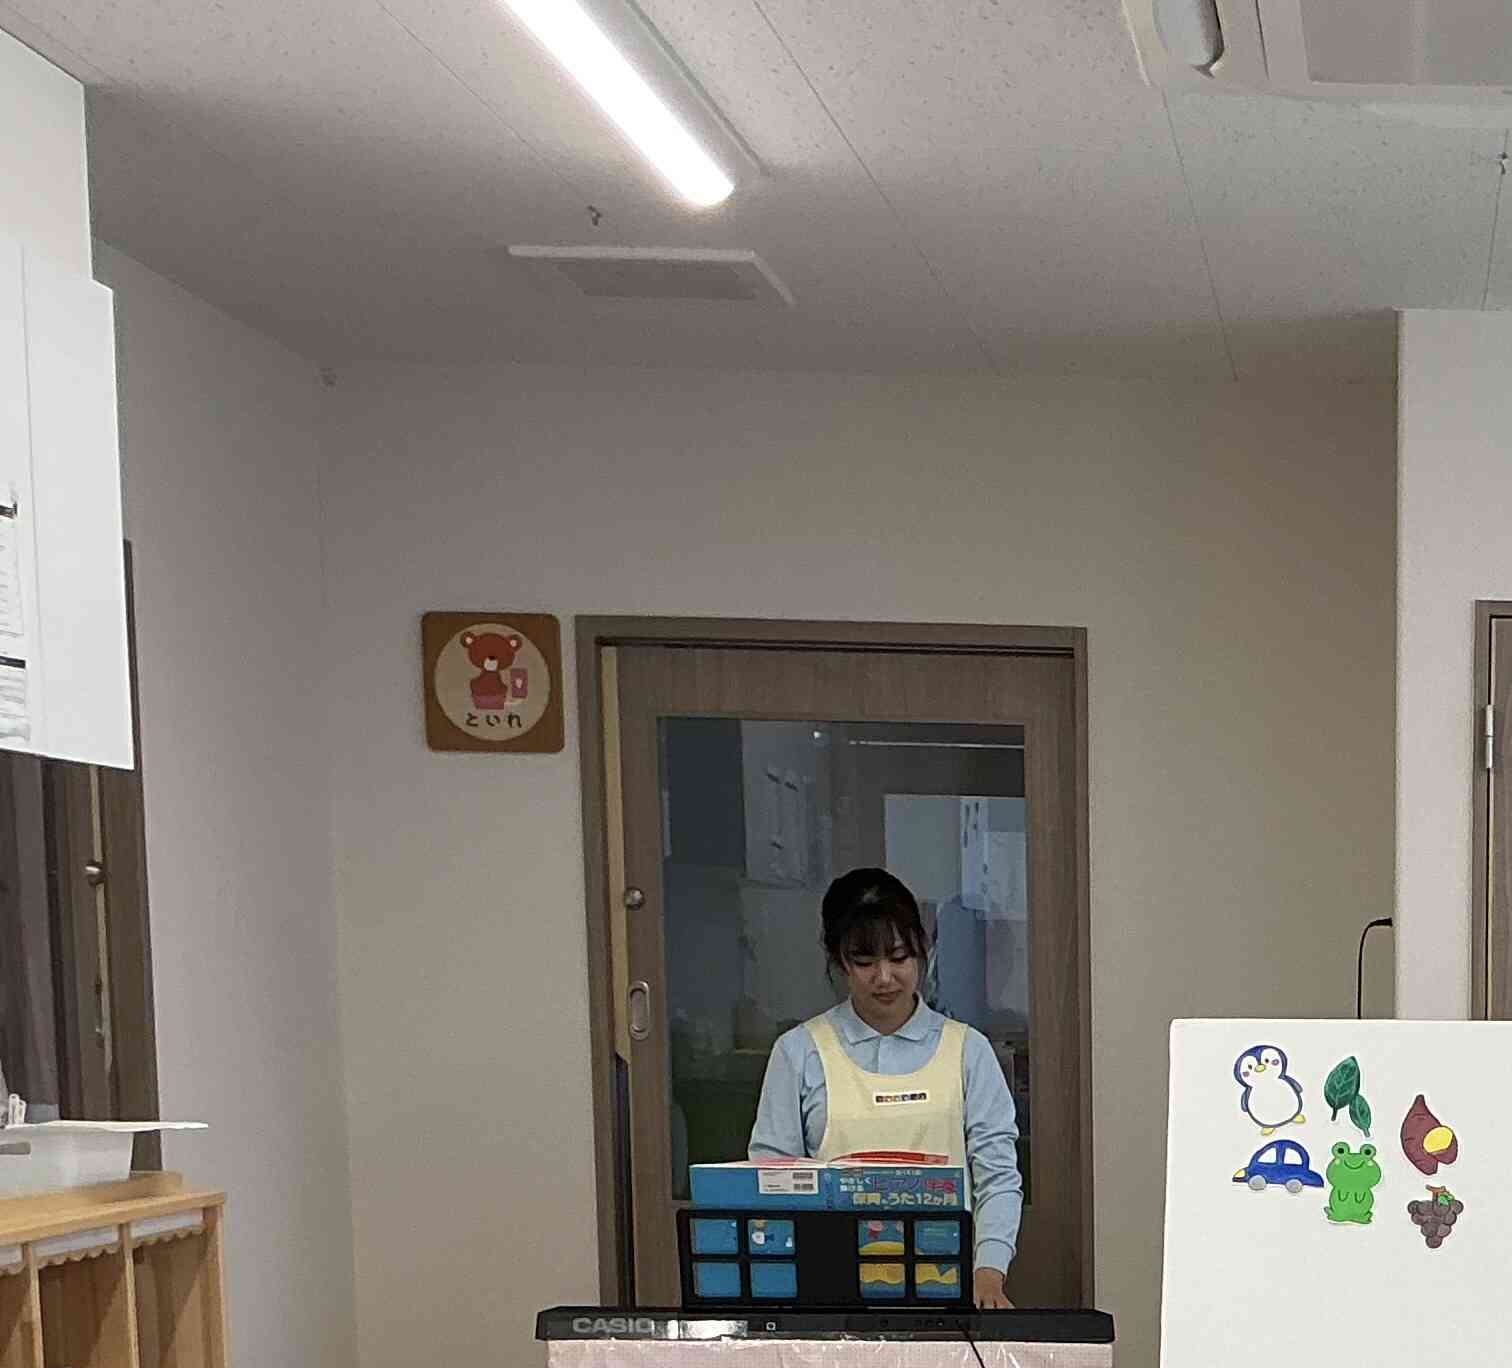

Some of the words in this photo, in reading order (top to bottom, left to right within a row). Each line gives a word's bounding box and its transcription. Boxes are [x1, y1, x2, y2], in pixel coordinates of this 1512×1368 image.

[465, 712, 522, 728] といれ
[572, 1317, 654, 1335] CASIO
